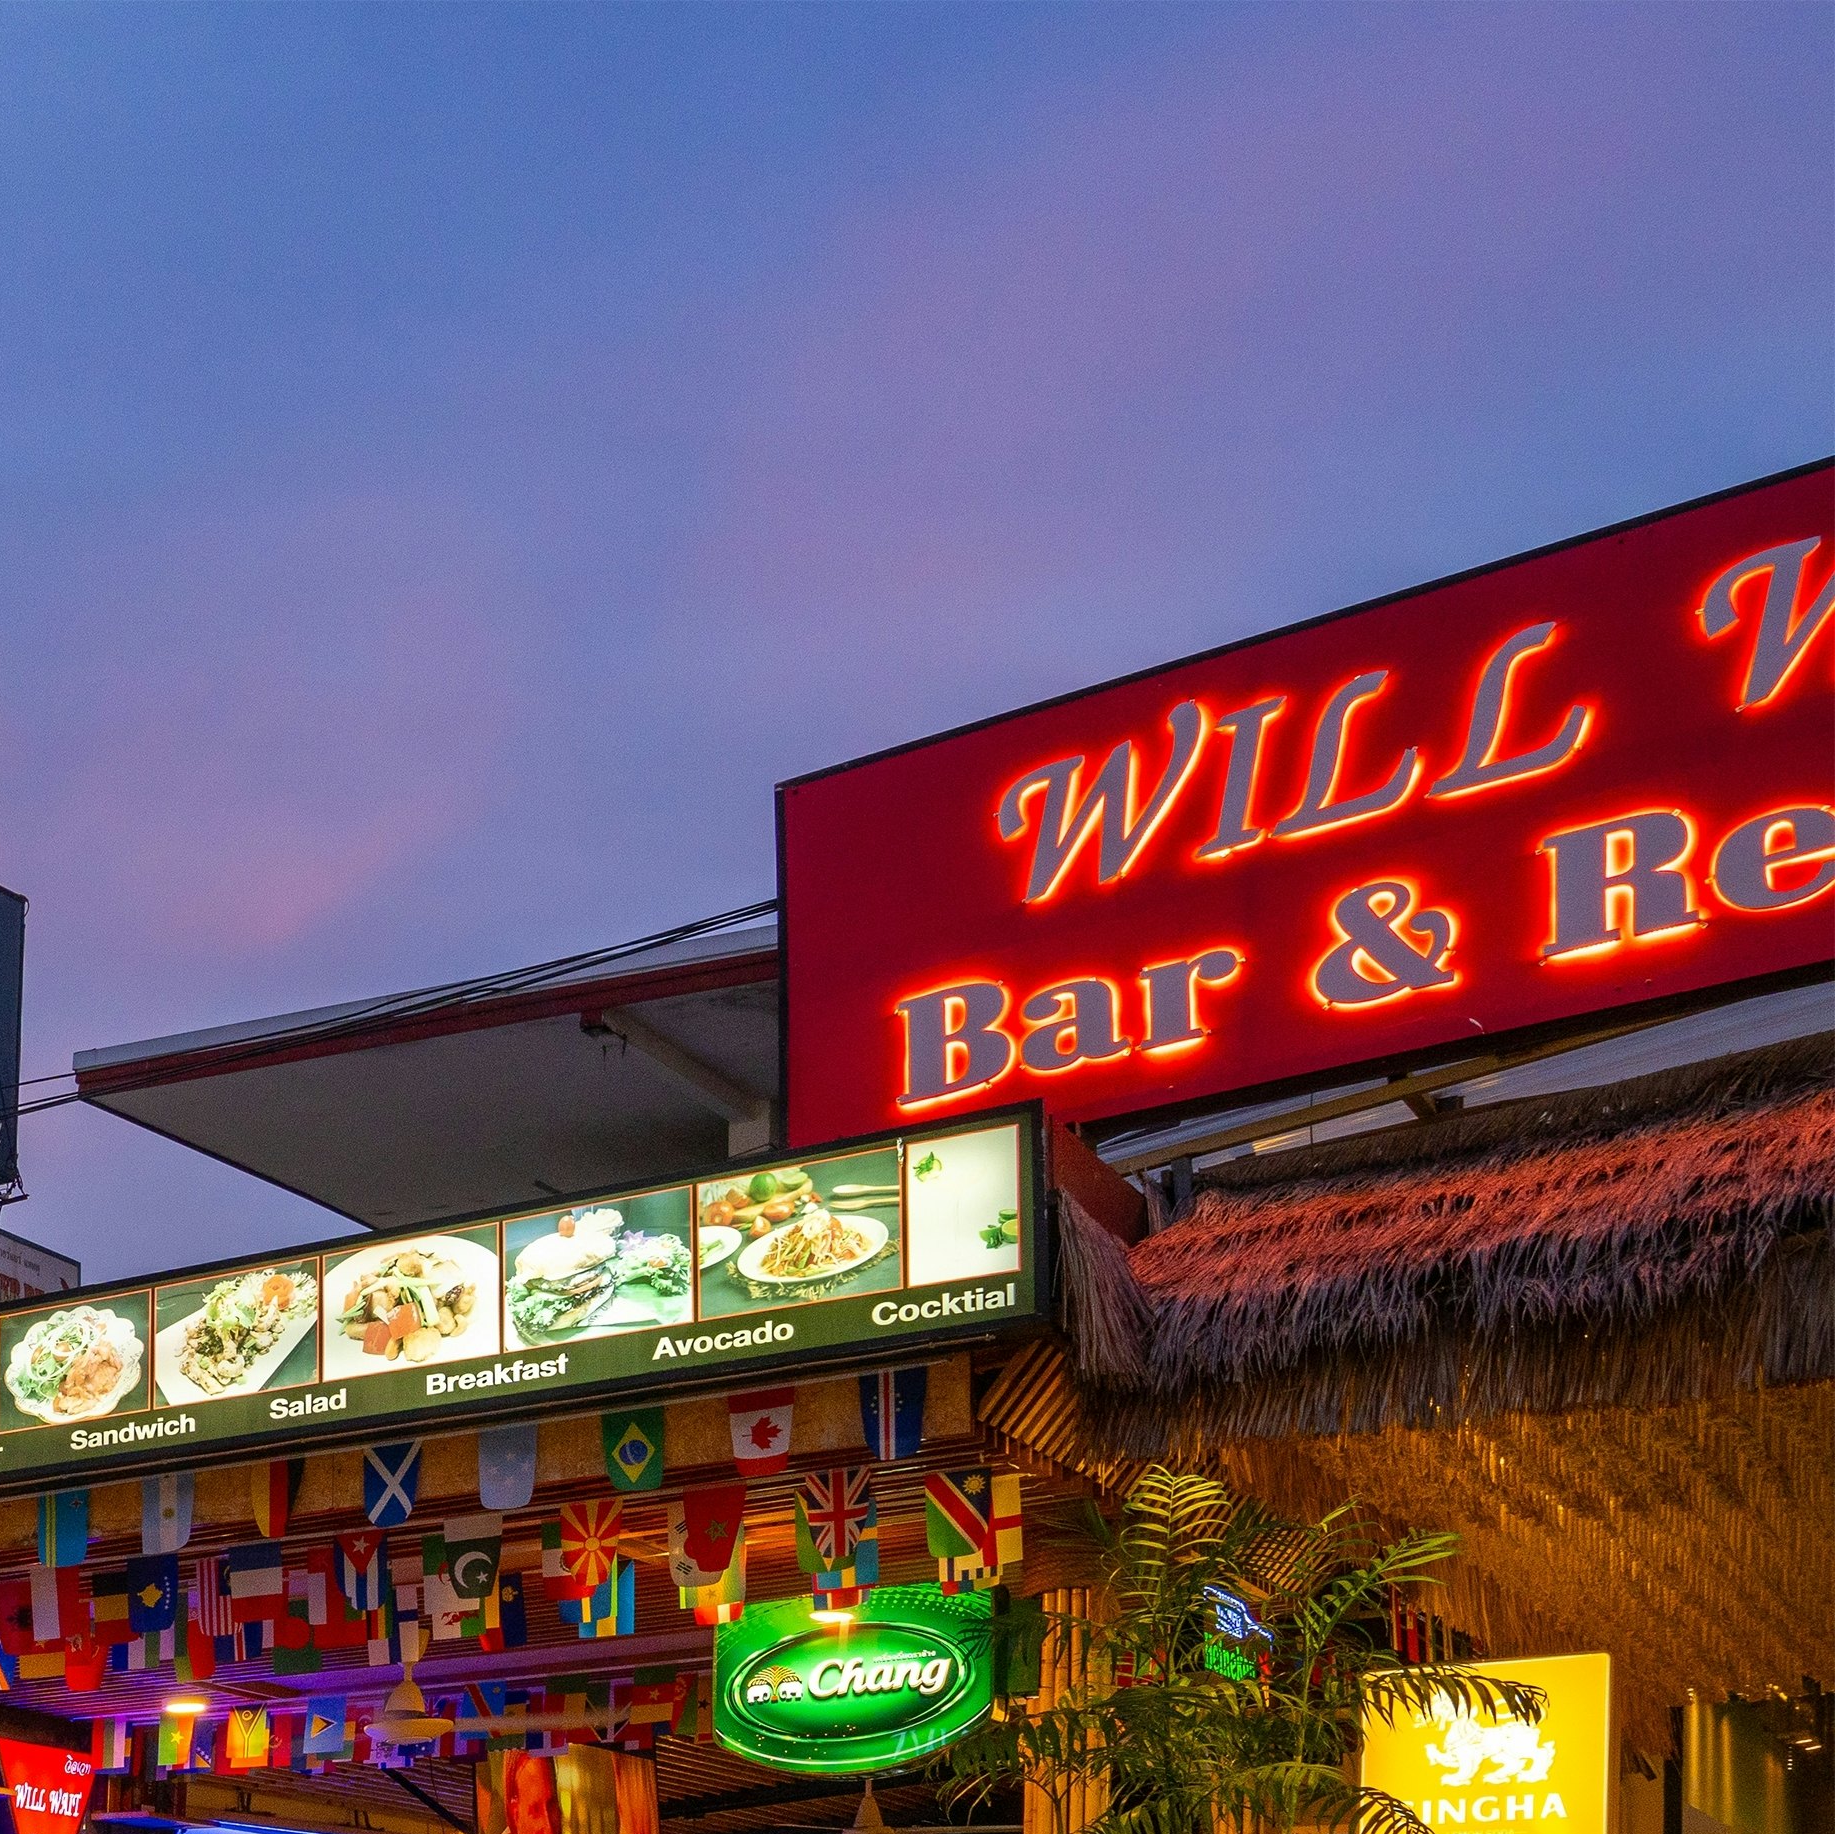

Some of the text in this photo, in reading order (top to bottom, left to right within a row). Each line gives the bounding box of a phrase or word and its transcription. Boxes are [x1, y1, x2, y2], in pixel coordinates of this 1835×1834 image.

[995, 618, 1595, 906] WILL
[895, 874, 1461, 1110] Bar &
[871, 1282, 1017, 1328] Cocktial
[651, 1317, 796, 1362] Avocado
[425, 1351, 570, 1398] Breakfast
[269, 1388, 347, 1422] Salad
[70, 1413, 197, 1451] Sandwich
[807, 1654, 953, 1698] Chang
[15, 1782, 83, 1819] WILL WAIT
